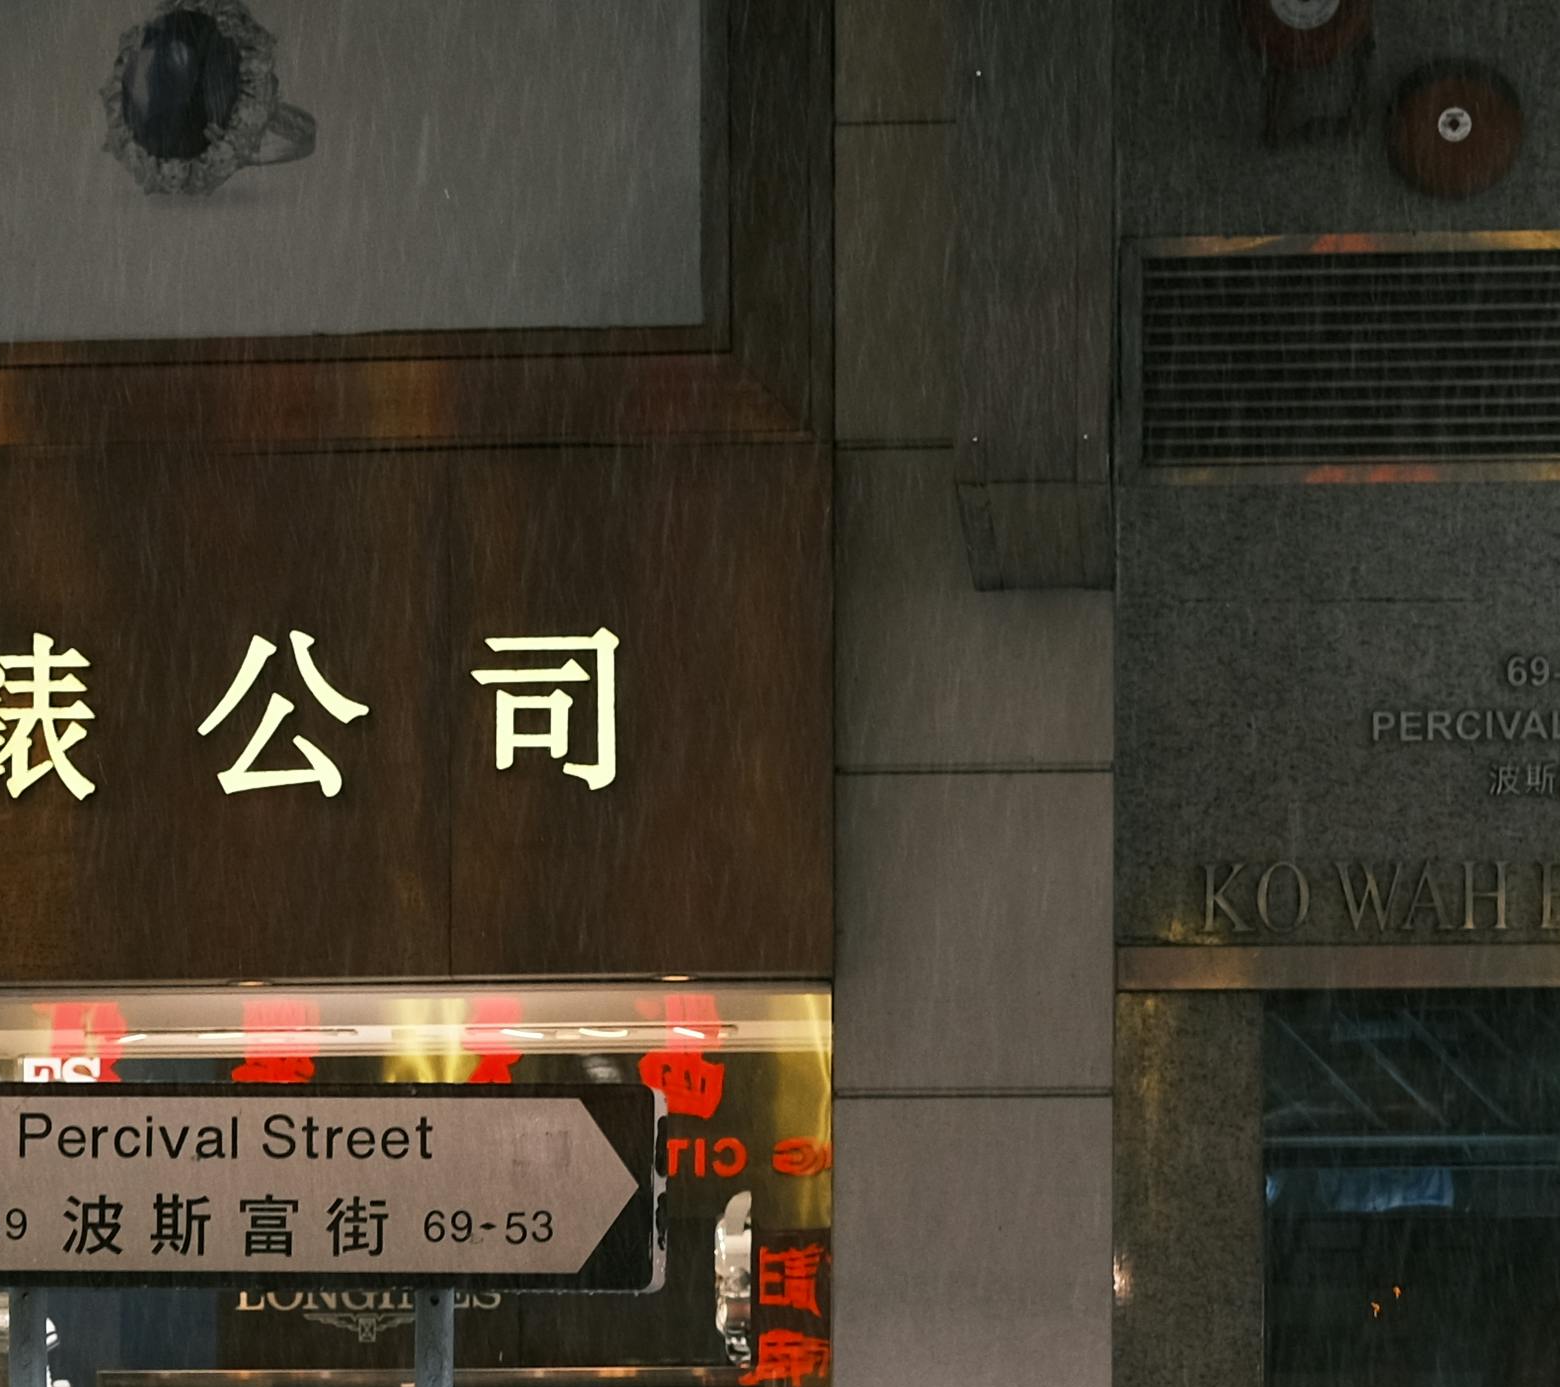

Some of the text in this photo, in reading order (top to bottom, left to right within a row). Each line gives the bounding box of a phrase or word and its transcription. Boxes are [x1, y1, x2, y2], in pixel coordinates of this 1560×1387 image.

[1201, 861, 1311, 933] KO
[1337, 860, 1511, 931] WAH
[16, 1112, 434, 1162] Percival Street
[61, 1194, 390, 1257] 波斯富街
[422, 1209, 555, 1245] 69-53
